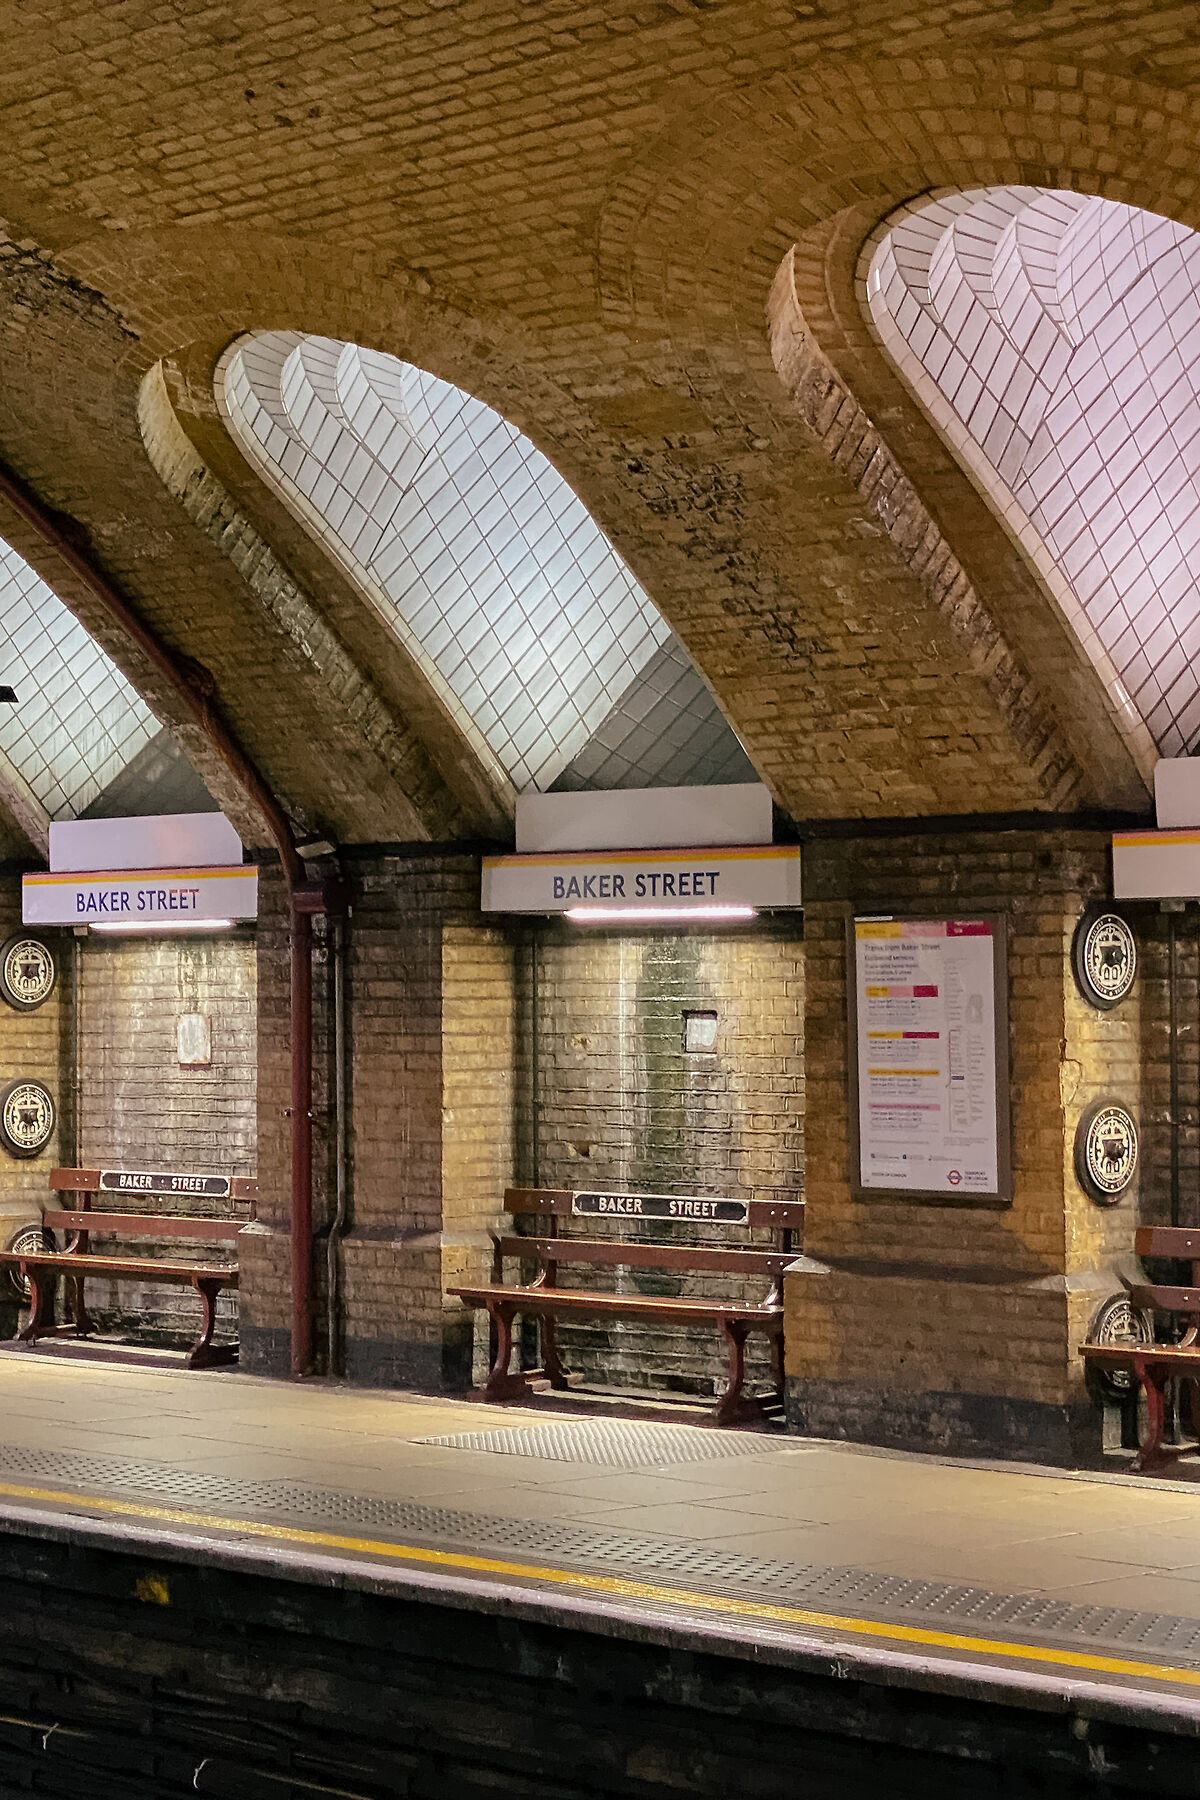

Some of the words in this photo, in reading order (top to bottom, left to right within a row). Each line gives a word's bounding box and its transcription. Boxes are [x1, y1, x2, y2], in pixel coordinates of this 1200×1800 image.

[553, 875, 626, 899] BAKER
[635, 872, 720, 897] STREET
[76, 891, 130, 912] BAKER
[137, 889, 199, 911] STREET
[119, 1174, 152, 1189] BAKER
[171, 1177, 207, 1191] STREET
[598, 1196, 643, 1214] BAKER
[668, 1200, 718, 1217] STREET
